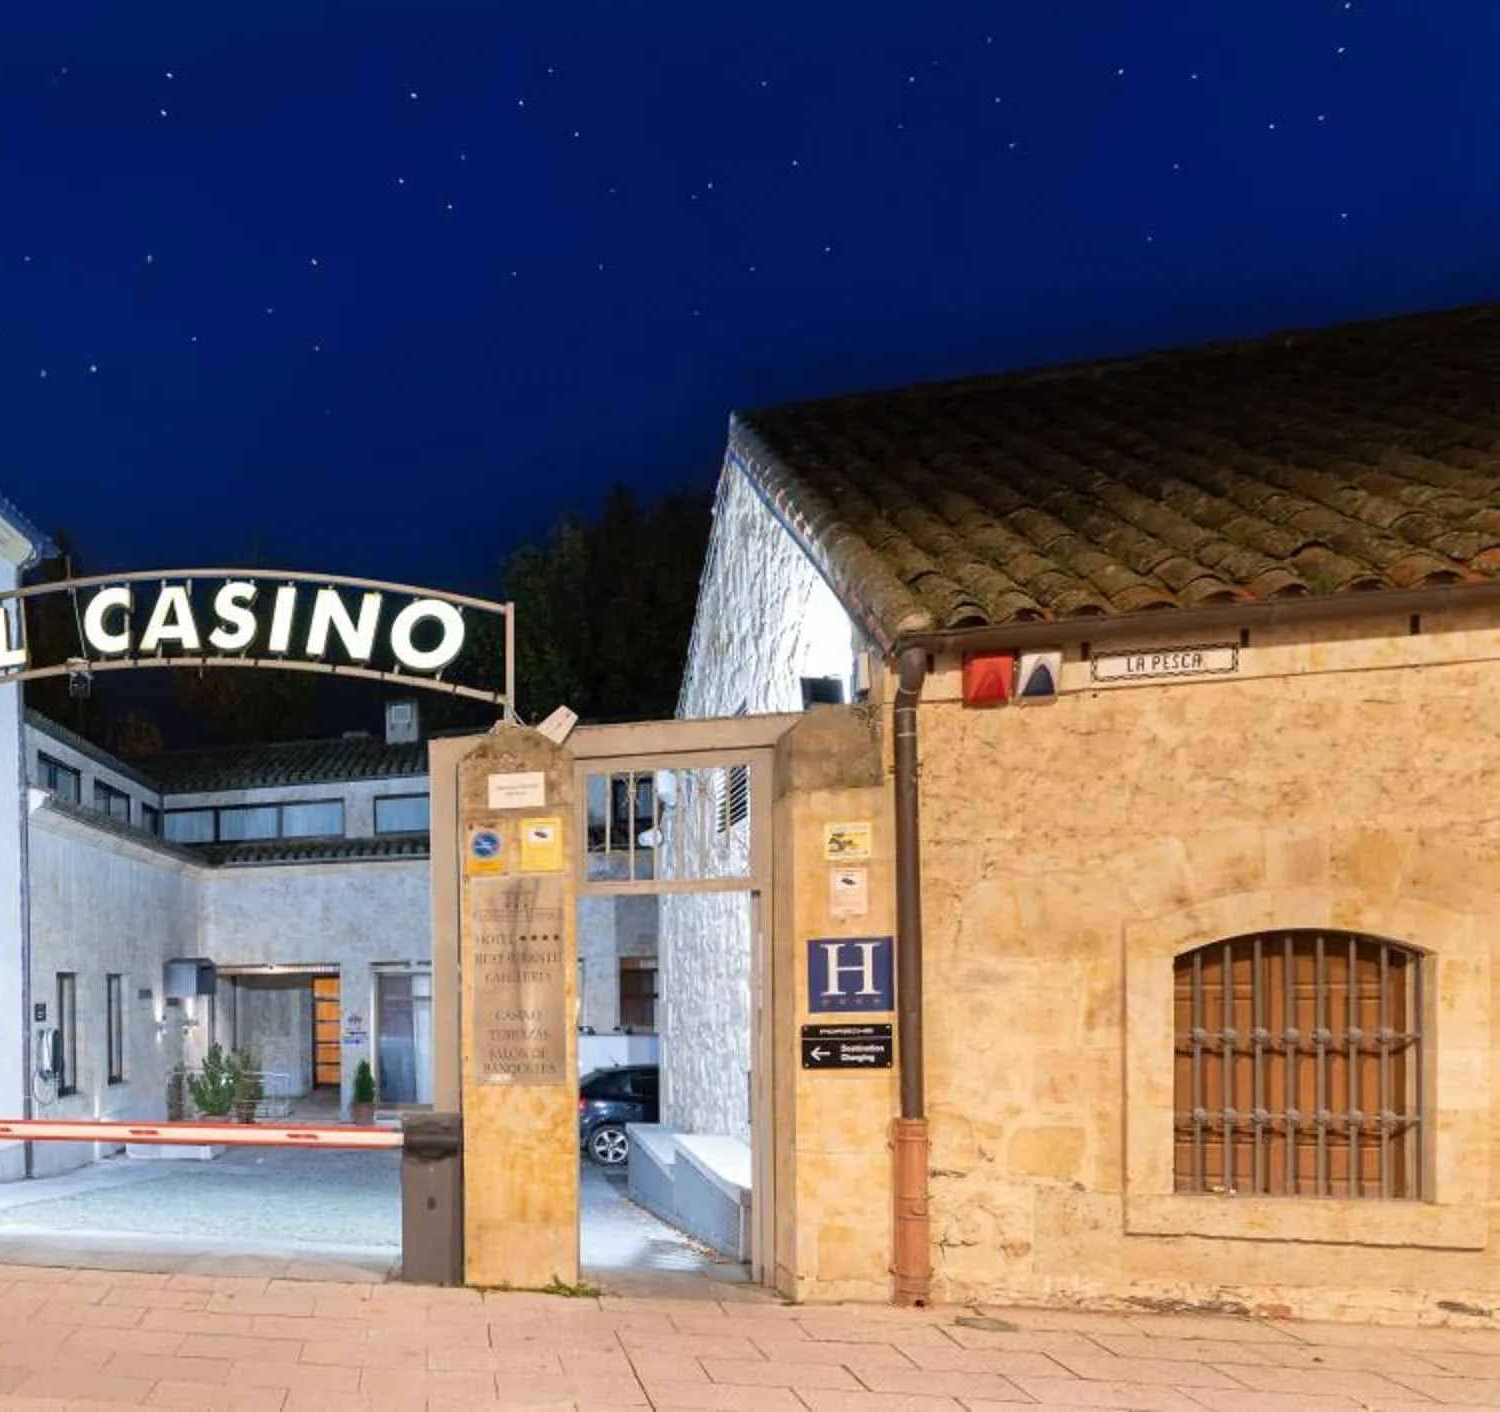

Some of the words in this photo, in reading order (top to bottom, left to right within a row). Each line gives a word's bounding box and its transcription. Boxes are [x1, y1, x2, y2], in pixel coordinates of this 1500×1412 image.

[84, 581, 466, 672] CASINO
[1127, 656, 1145, 672] LA
[1152, 653, 1202, 671] PESCA
[819, 942, 882, 996] H
